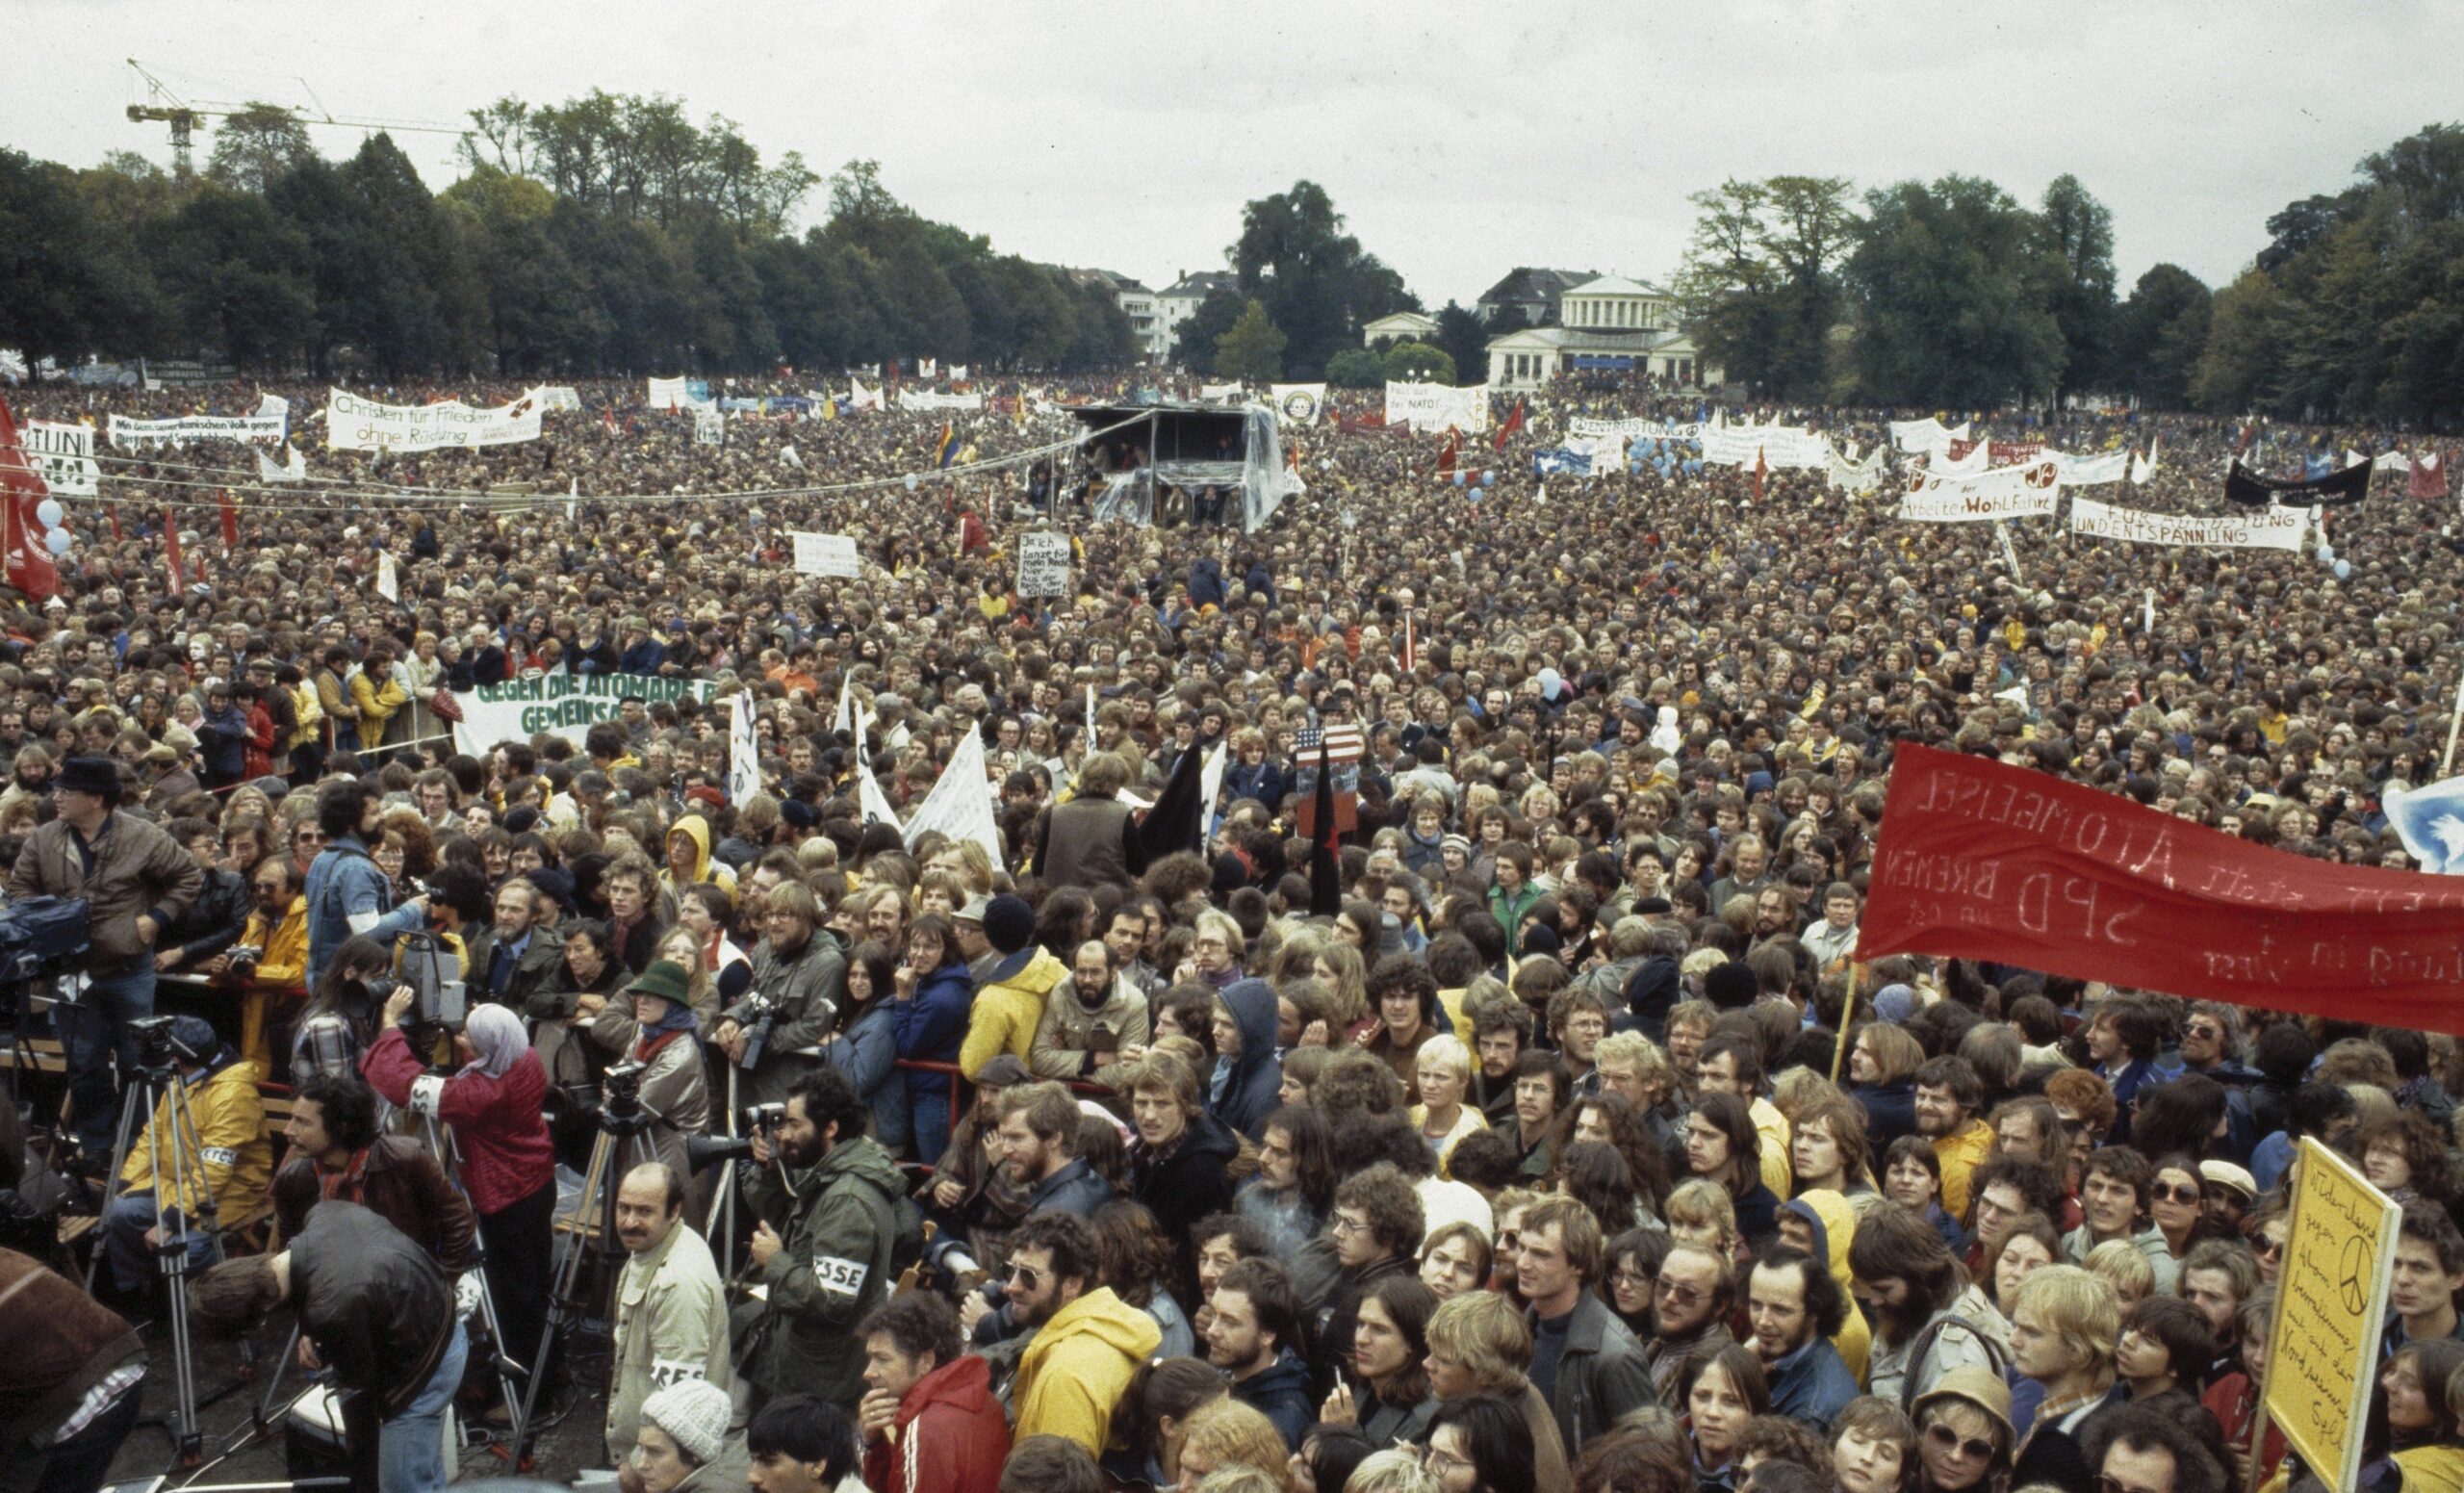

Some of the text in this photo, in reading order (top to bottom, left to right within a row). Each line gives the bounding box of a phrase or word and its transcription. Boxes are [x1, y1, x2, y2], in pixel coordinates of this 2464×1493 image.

[336, 395, 403, 423] Christen
[435, 405, 493, 425] Frieden
[251, 421, 280, 431] gegen
[409, 425, 469, 446] Rüstung
[2075, 517, 2248, 543] UND ENTSPANNUNG
[477, 676, 544, 703] GEGEN
[548, 674, 580, 701] DIE
[585, 674, 695, 704] ATOMARE
[521, 699, 623, 734] GEMEINSA
[816, 1260, 862, 1288] SSE
